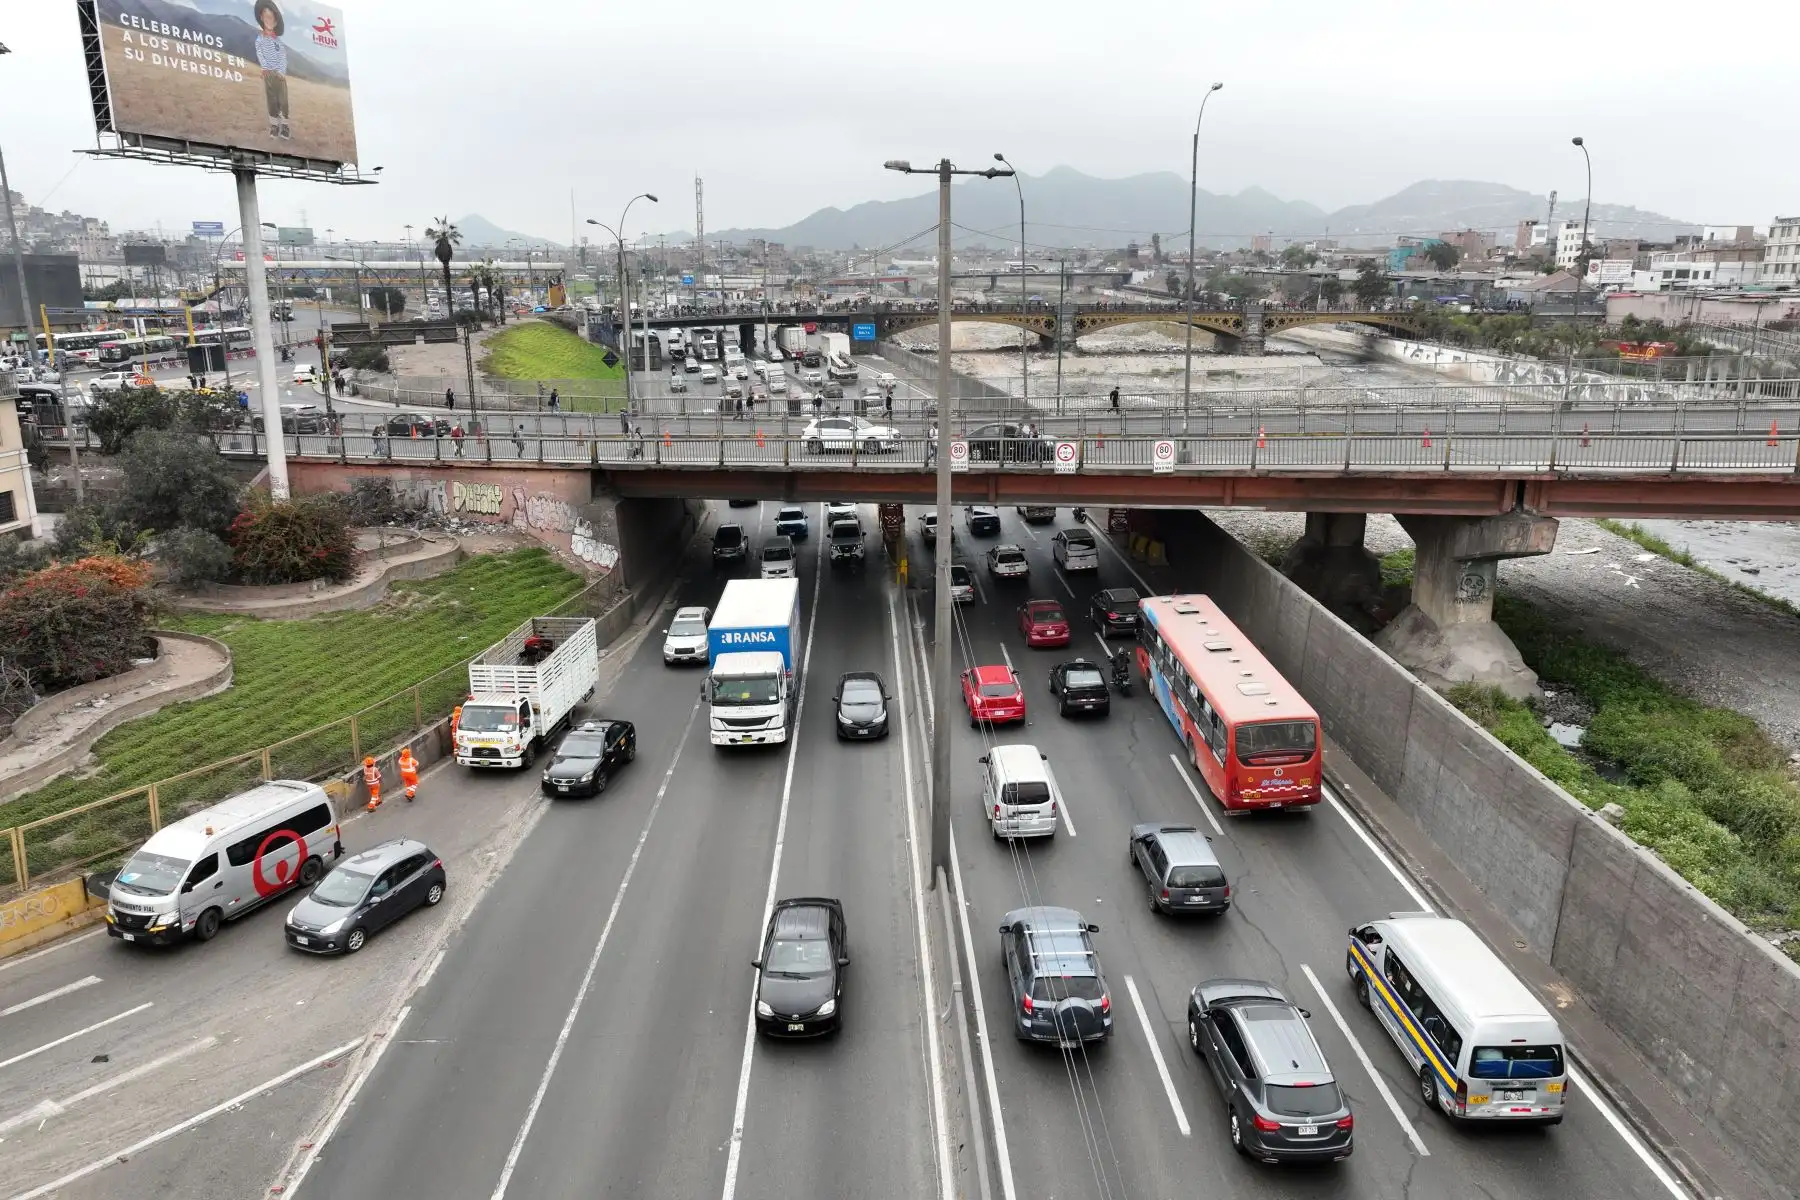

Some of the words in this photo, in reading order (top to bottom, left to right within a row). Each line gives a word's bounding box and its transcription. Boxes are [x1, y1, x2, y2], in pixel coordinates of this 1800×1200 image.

[120, 13, 223, 48] CELEBRAMOS
[123, 31, 133, 43] A
[140, 34, 169, 51] LOS
[176, 44, 222, 63] NIÑOS
[228, 55, 245, 68] EN
[124, 47, 145, 62] SU
[152, 53, 243, 82] DIVERSIDAD
[734, 632, 775, 643] RANSA
